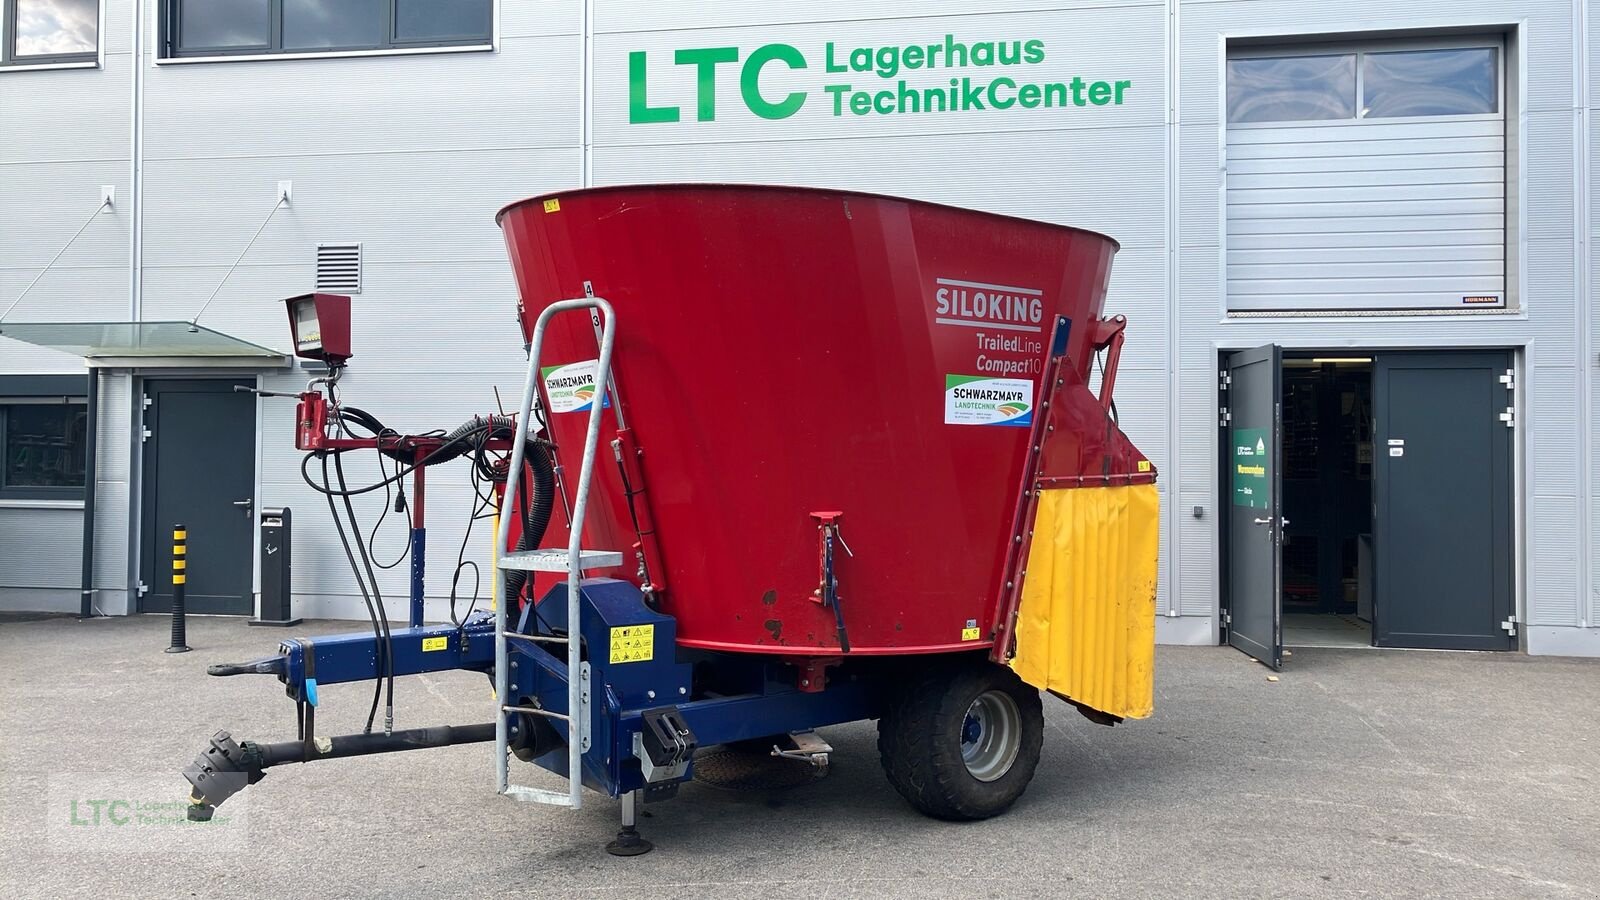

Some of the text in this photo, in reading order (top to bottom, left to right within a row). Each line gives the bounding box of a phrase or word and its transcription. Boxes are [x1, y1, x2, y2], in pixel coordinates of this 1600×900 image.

[825, 34, 1046, 78] Lagerhaus
[628, 43, 808, 125] LTC
[825, 77, 1131, 117] TechnikCenter
[586, 284, 593, 296] 4
[936, 287, 1042, 323] SILOKING
[592, 315, 600, 327] 3
[976, 333, 1042, 353] TrailedLine
[976, 354, 1042, 376] Compact10
[546, 374, 594, 389] SCHWARZMAYR
[953, 388, 1023, 402] SCHWARZMAYR
[954, 401, 996, 411] LANDTECHNIK
